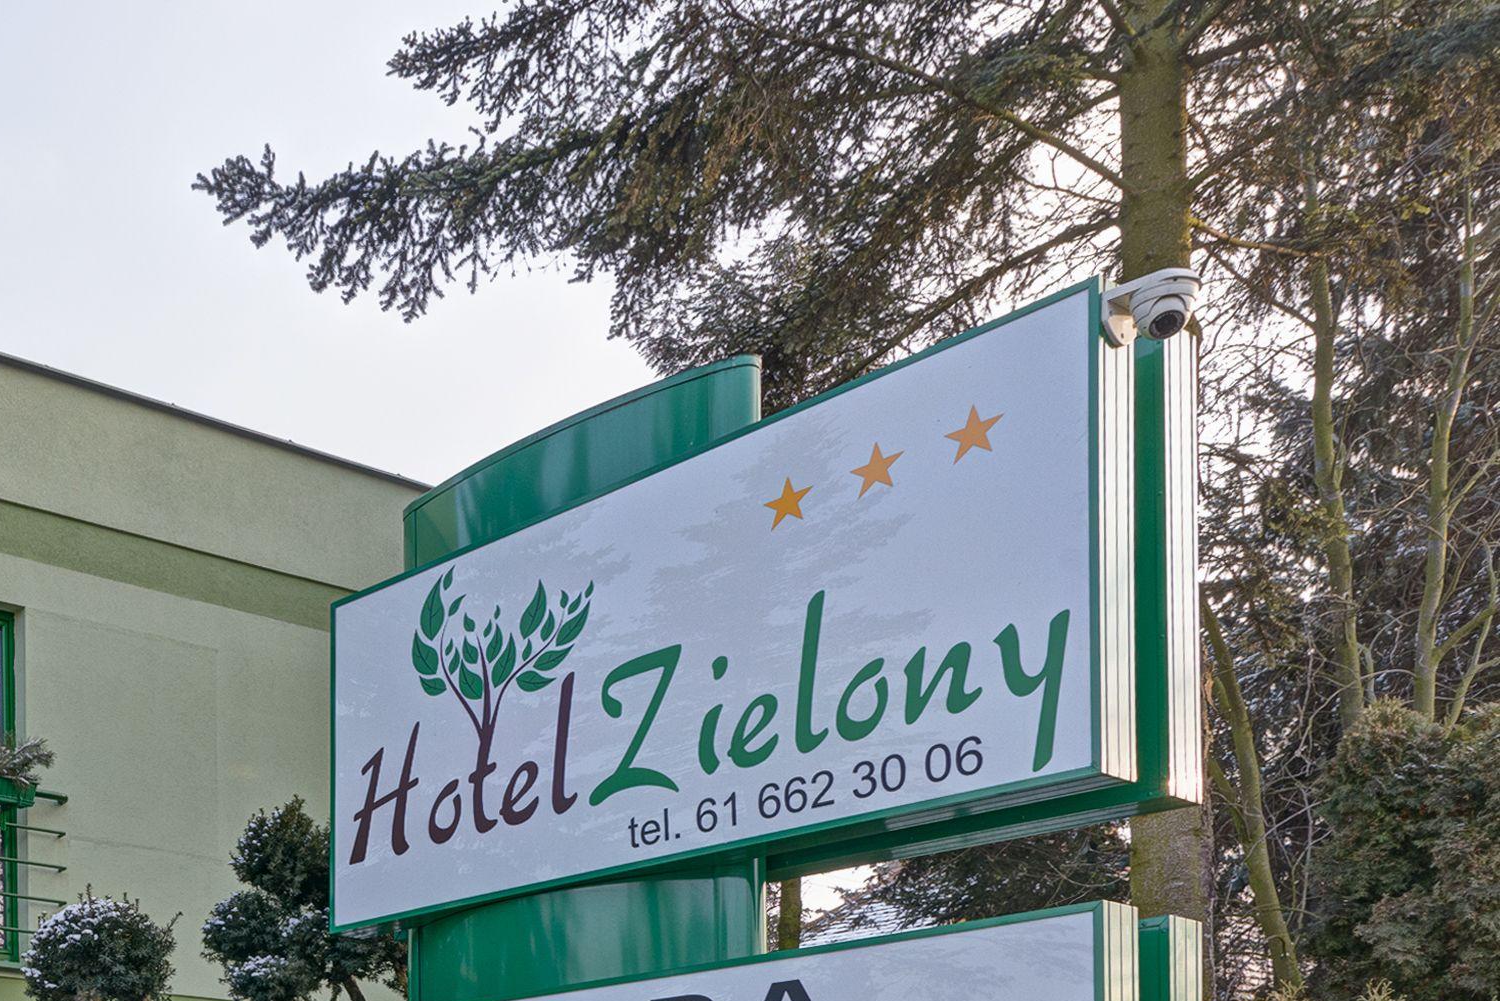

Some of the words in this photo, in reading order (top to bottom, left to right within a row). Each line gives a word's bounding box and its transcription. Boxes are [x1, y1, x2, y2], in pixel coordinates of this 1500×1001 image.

[349, 672, 578, 866] Hotel
[588, 590, 1071, 806] Zielony
[628, 807, 682, 849] tel.
[696, 792, 738, 833] 61
[758, 769, 836, 819] 662
[852, 753, 907, 799] 30
[925, 735, 984, 783] 06
